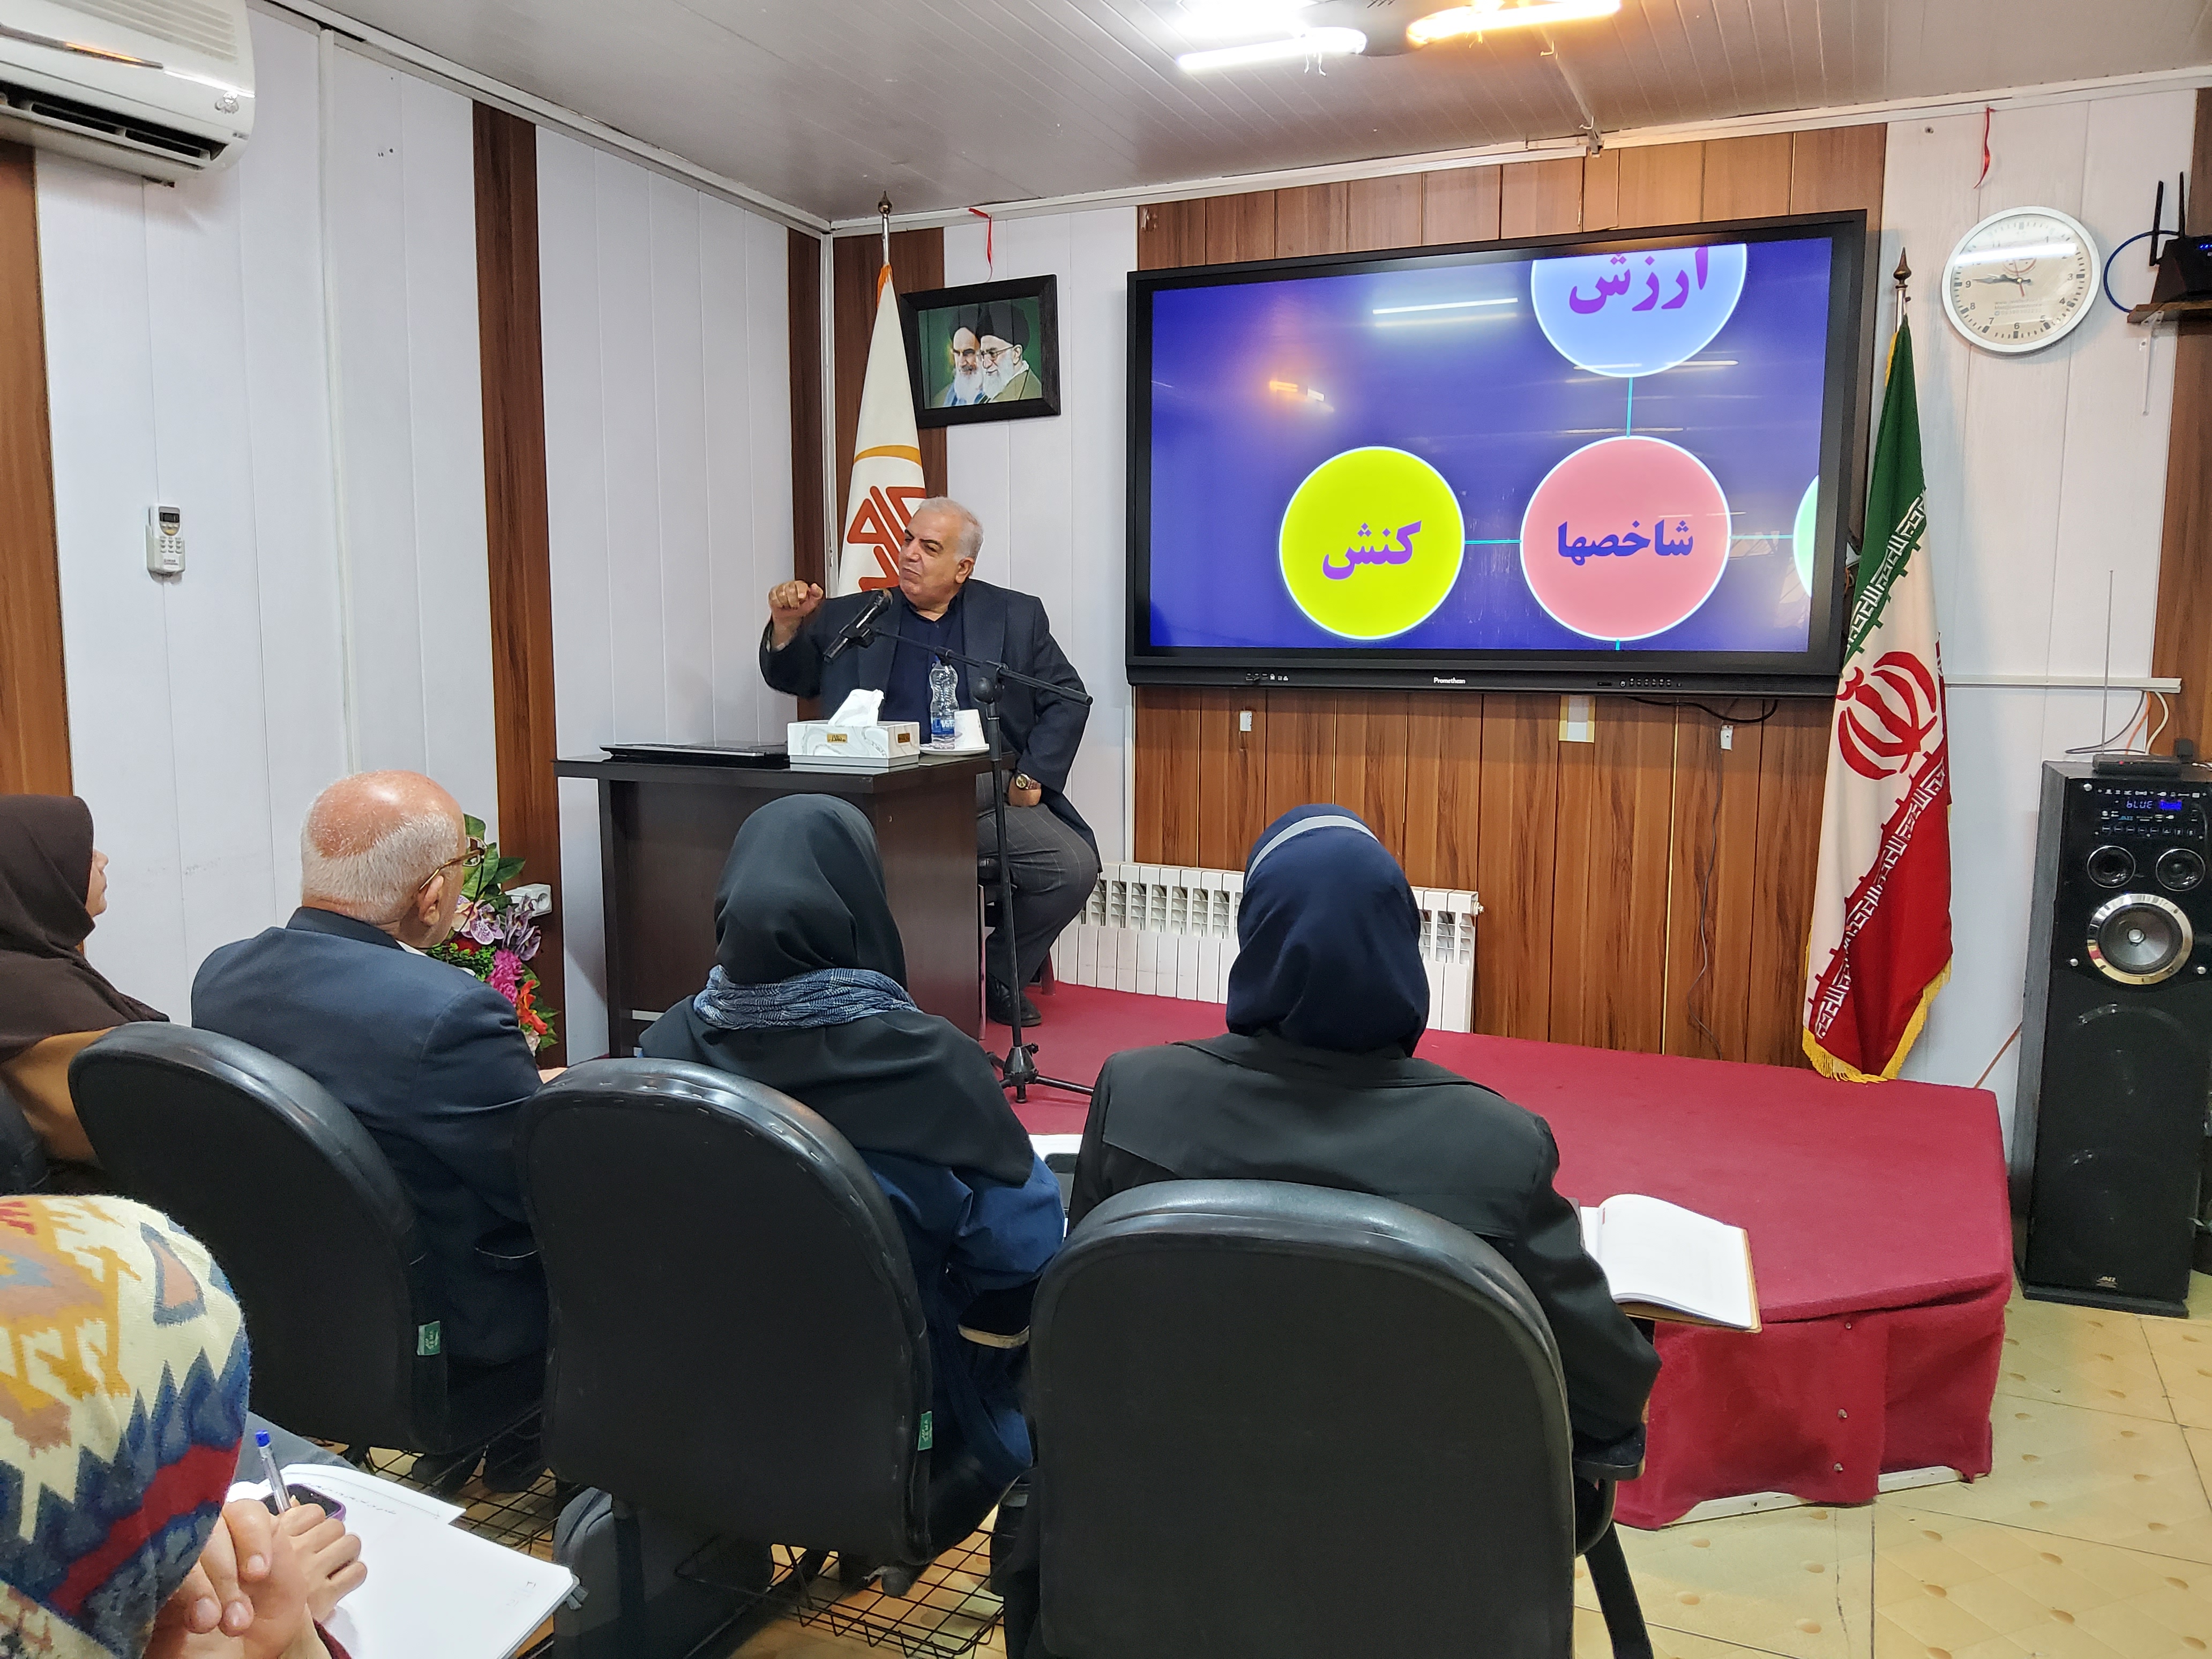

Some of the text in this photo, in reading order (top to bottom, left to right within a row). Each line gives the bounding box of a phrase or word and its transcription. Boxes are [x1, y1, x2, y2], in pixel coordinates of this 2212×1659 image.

[1569, 246, 1708, 314] ارزش
[2067, 273, 2074, 281] 3
[1964, 280, 1971, 288] 9
[2059, 297, 2066, 305] 4
[1970, 302, 1976, 310] 8
[2014, 322, 2020, 330] 6
[1558, 519, 1693, 565] شاخصها
[1322, 520, 1422, 580] کنش
